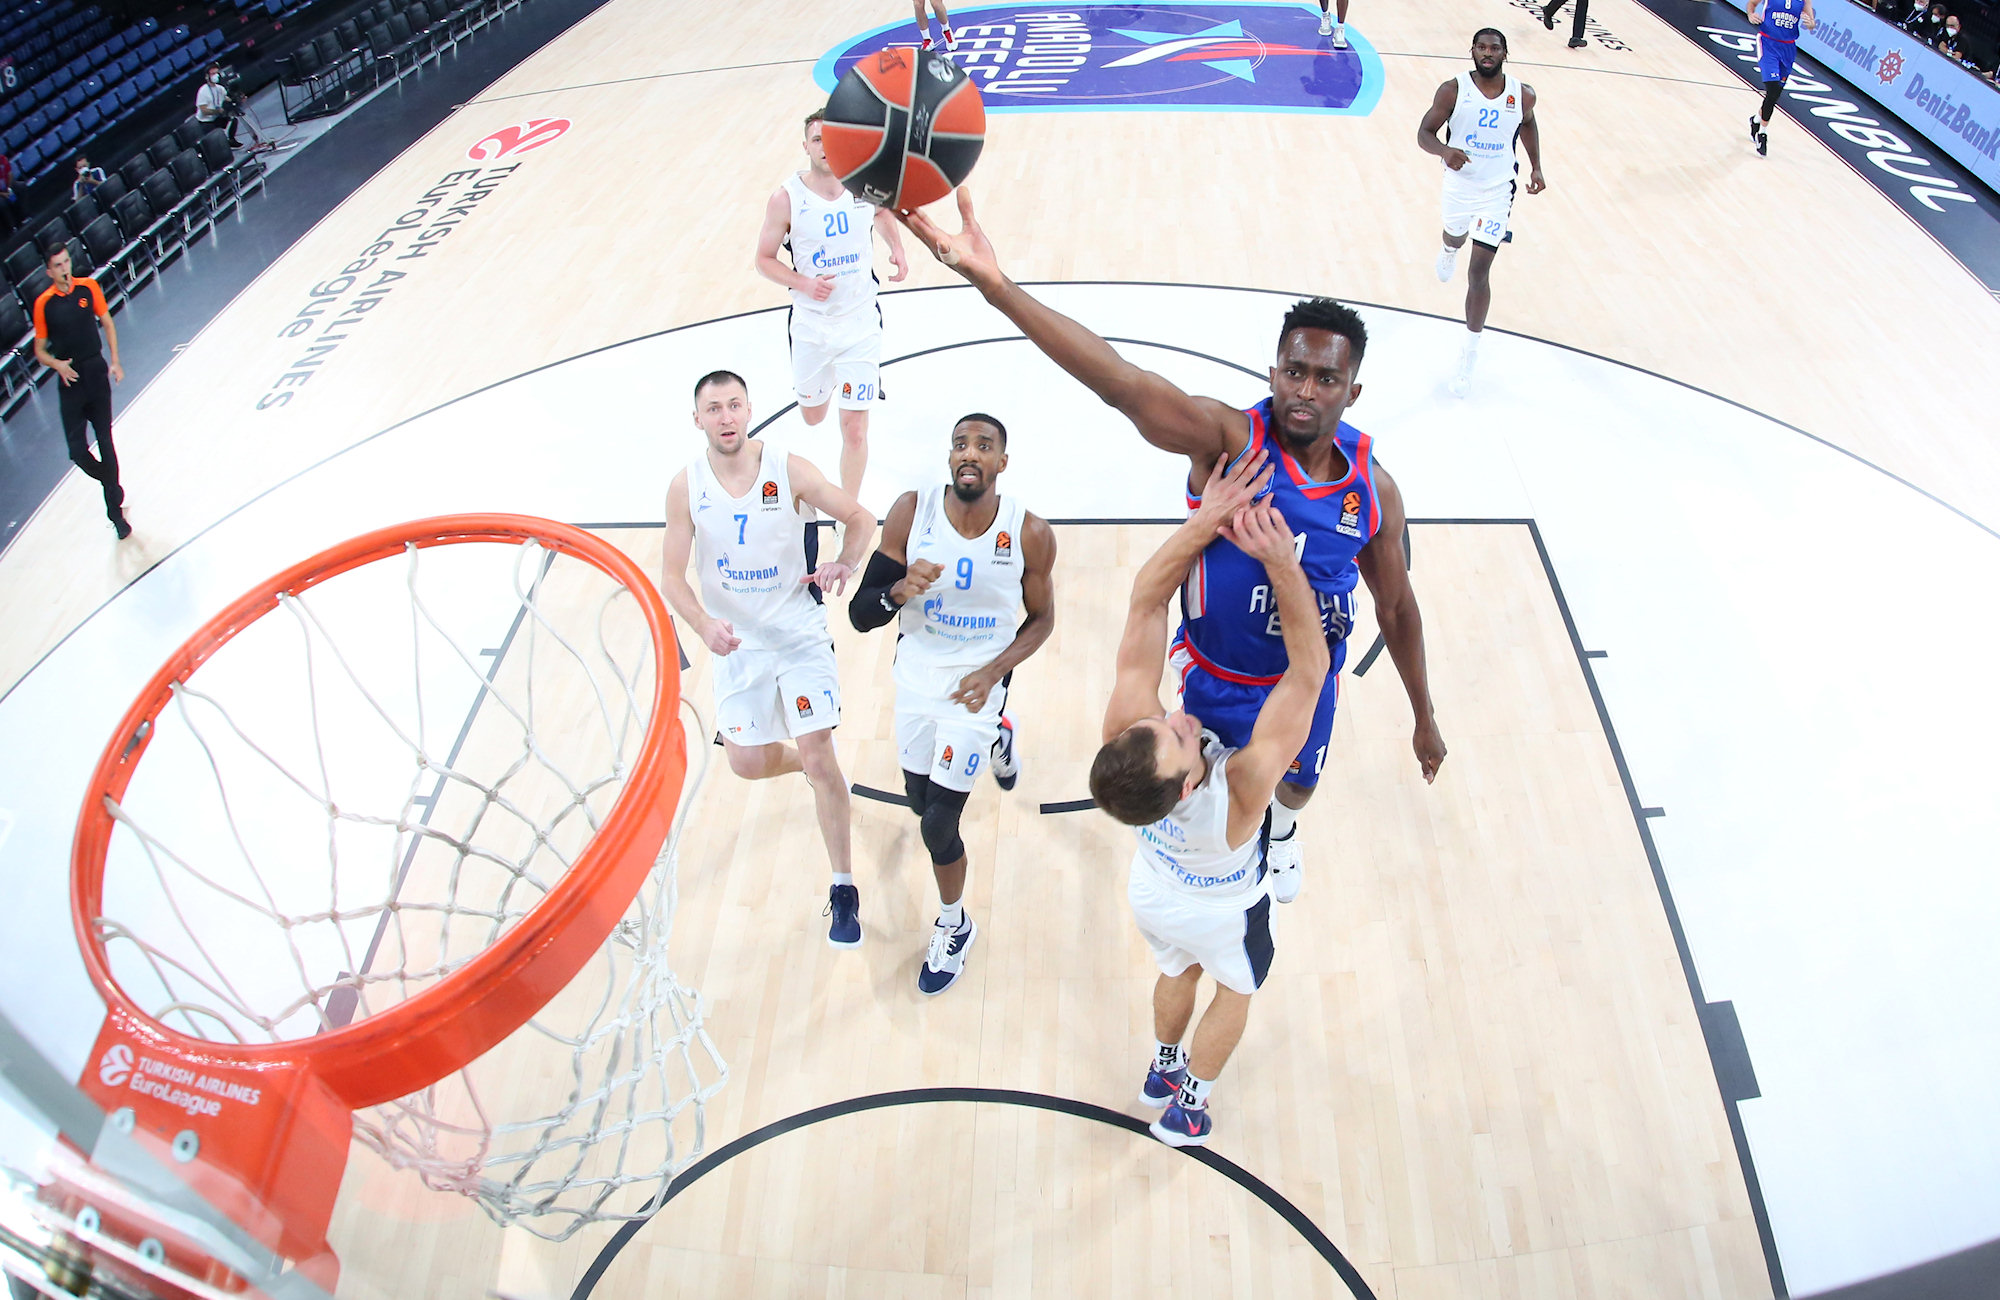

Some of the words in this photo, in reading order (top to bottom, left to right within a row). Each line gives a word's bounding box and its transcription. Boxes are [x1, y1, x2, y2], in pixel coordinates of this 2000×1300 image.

[1771, 11, 1798, 24] ANADOLU
[1774, 19, 1794, 29] EFES
[982, 12, 1093, 94] ANADOLU
[1478, 108, 1500, 129] 22
[1904, 72, 2000, 162] DenizBank
[395, 161, 523, 261] TURKISH
[823, 210, 850, 238] 20
[1484, 219, 1500, 237] 22
[276, 167, 482, 339] EuroLeague
[255, 269, 408, 411] AIRLINES
[857, 384, 875, 401] 20
[733, 513, 749, 545] 7
[1294, 531, 1308, 565] 1
[731, 565, 779, 581] GAZPROM
[955, 556, 974, 591] 9
[1265, 611, 1346, 640] ES
[823, 690, 835, 712] 7
[964, 752, 980, 777] 9
[1315, 744, 1327, 775] 1
[128, 1072, 222, 1117] EuroLeague
[138, 1056, 196, 1086] TURKISH
[195, 1074, 262, 1106] AIRLINES
